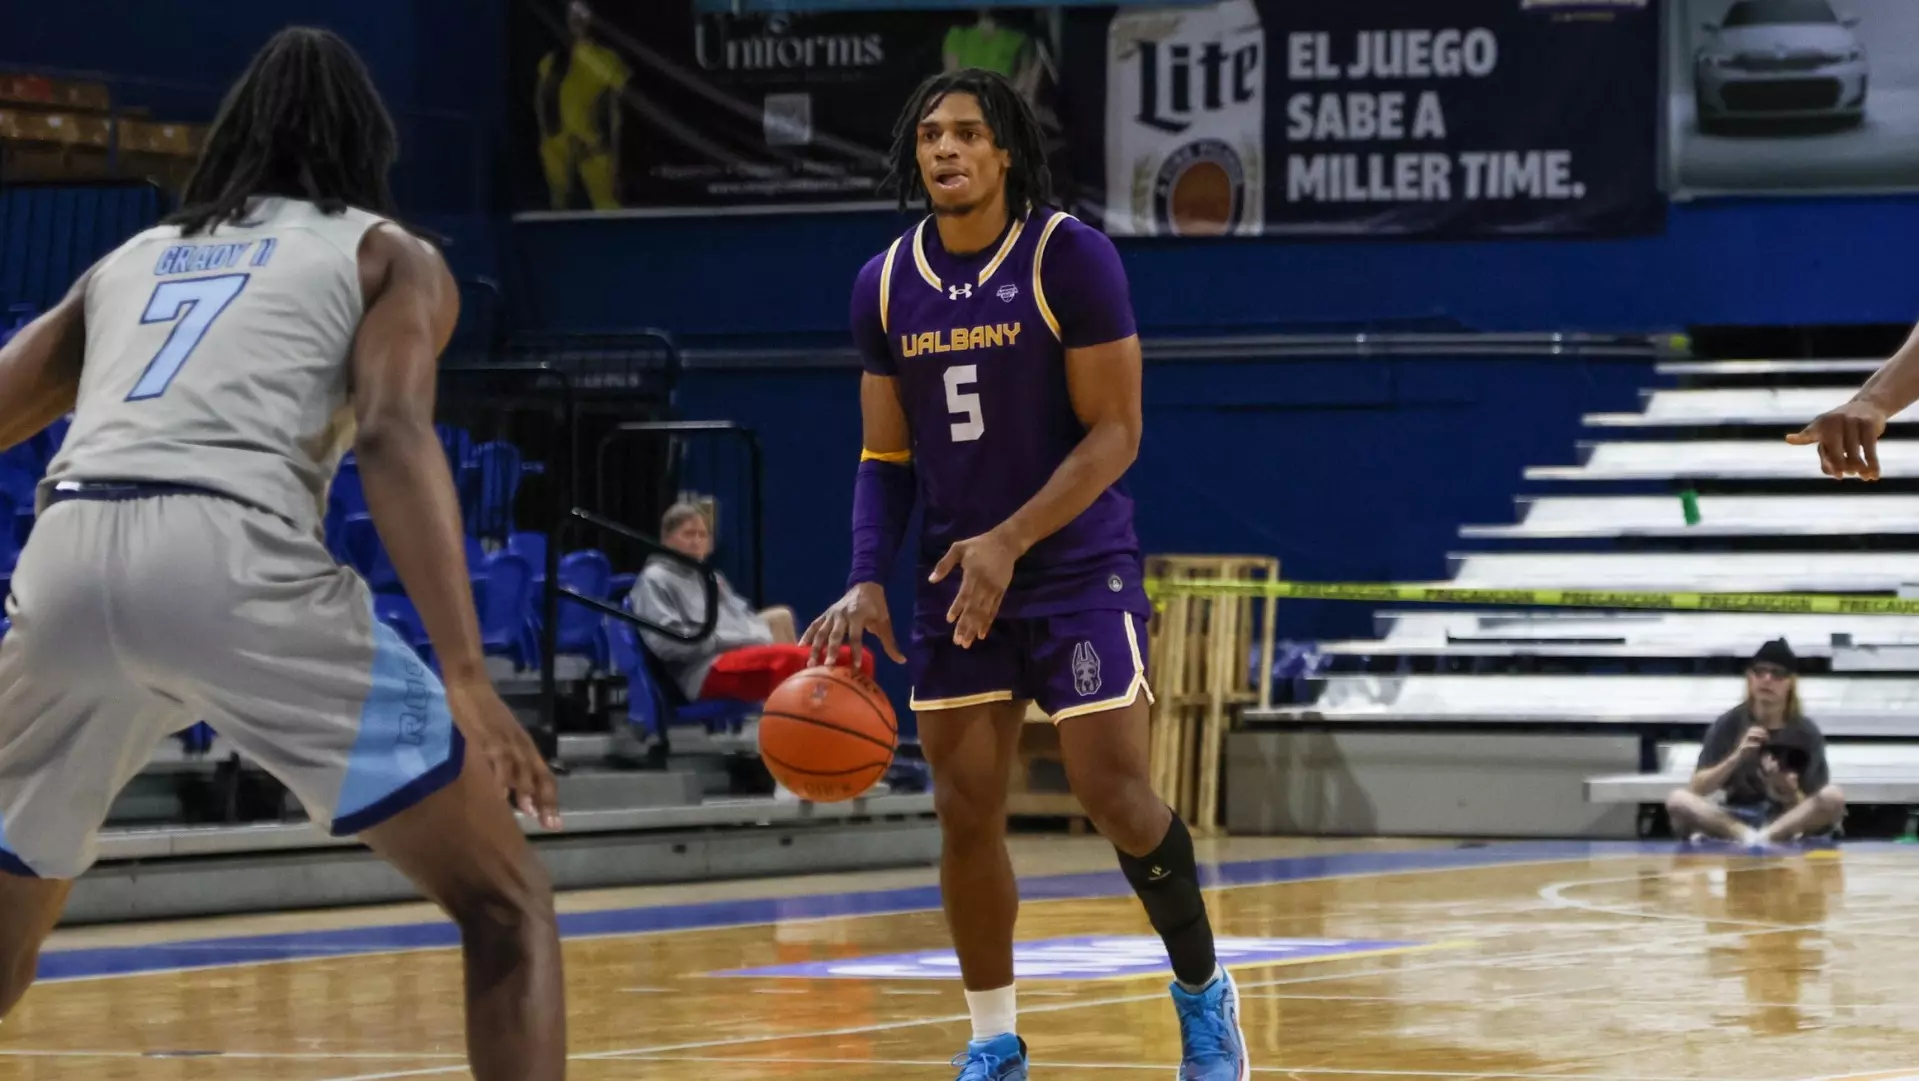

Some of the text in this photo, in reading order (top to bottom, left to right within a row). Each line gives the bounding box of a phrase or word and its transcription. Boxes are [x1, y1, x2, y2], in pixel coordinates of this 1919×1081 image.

[1287, 27, 1498, 80] EL JUEGO
[1117, 39, 1258, 134] Lite
[1286, 90, 1447, 140] SABE A
[1286, 153, 1453, 202] MILLER
[1458, 149, 1587, 200] TIME.
[124, 272, 251, 403] 7
[901, 322, 1021, 358] UALBANY
[942, 364, 985, 443] 5
